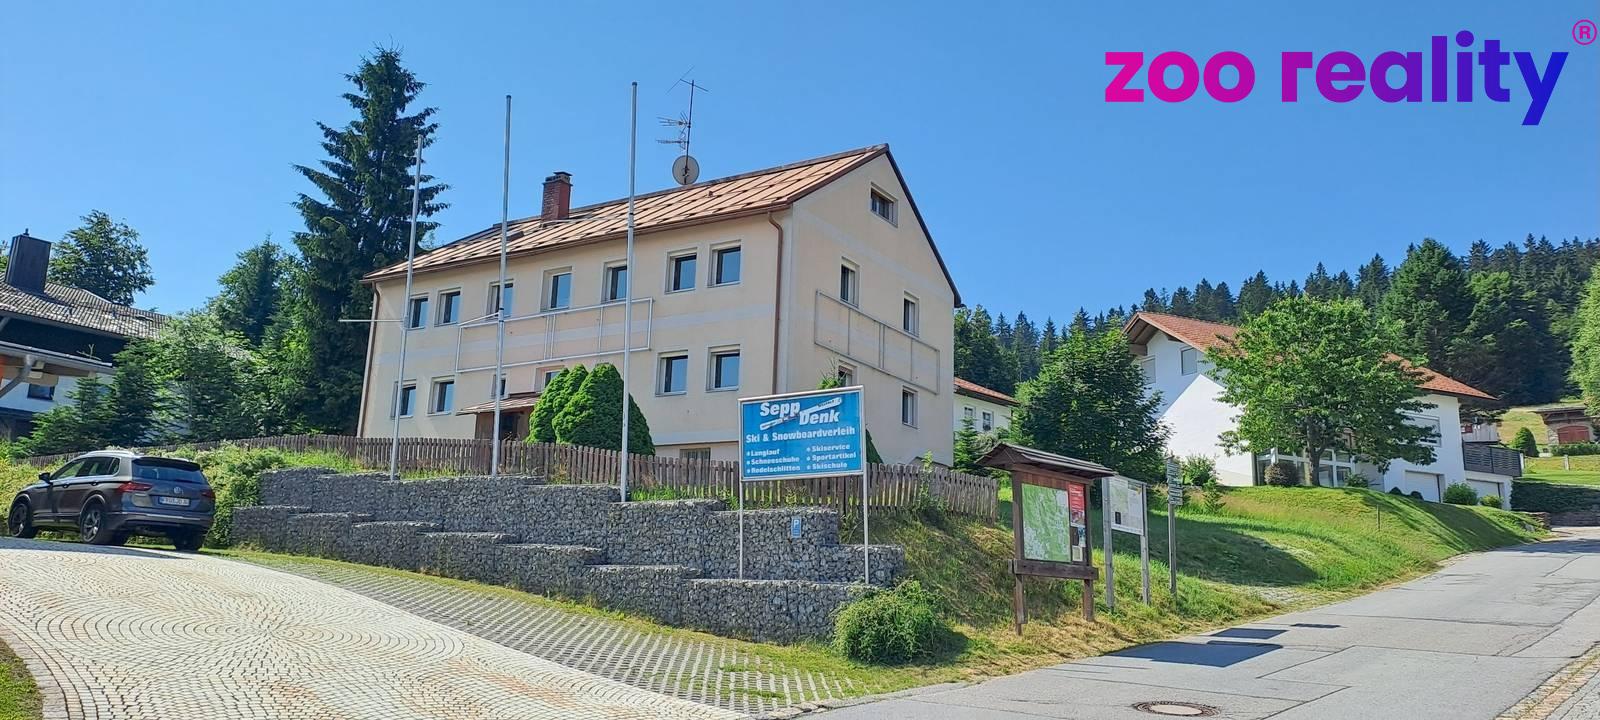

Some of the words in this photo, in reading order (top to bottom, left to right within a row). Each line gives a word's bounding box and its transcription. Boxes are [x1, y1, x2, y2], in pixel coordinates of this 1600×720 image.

[760, 402, 800, 418] Sepp
[799, 409, 840, 425] Denk
[746, 434, 760, 443] Ski
[763, 433, 769, 442] &
[772, 427, 856, 441] Snowboardverleih
[751, 448, 780, 457] Langlauf
[811, 444, 850, 452] Skiservice
[751, 457, 800, 465] Schneeschuhe
[812, 452, 857, 461] Sportartikel
[751, 465, 800, 474] Rodelschlitten
[812, 461, 848, 470] Skischule
[793, 519, 800, 529] P
